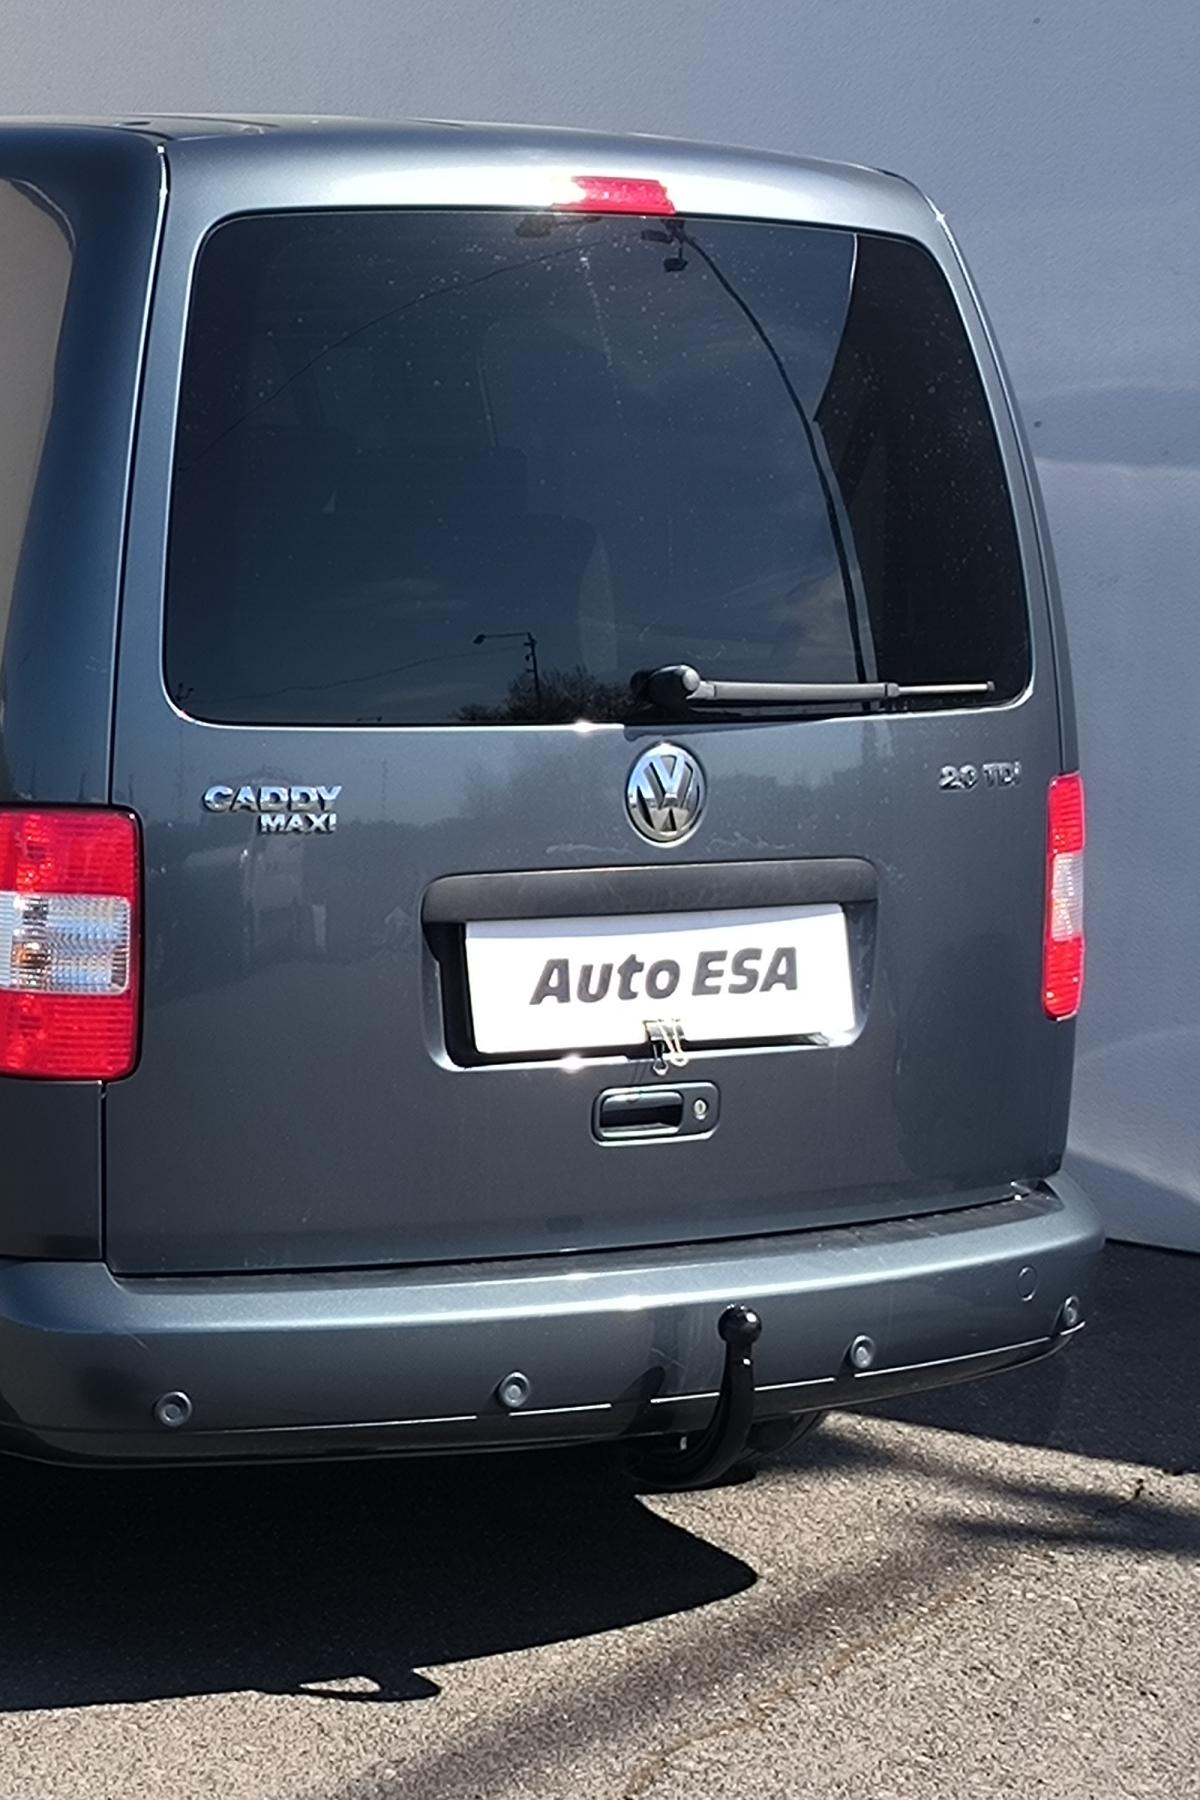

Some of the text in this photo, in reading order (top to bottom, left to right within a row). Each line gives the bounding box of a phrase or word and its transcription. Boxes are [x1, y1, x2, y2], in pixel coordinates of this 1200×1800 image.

[203, 785, 342, 812] CADDY
[259, 813, 337, 832] MAXI
[529, 947, 798, 1005] Auto ESA
